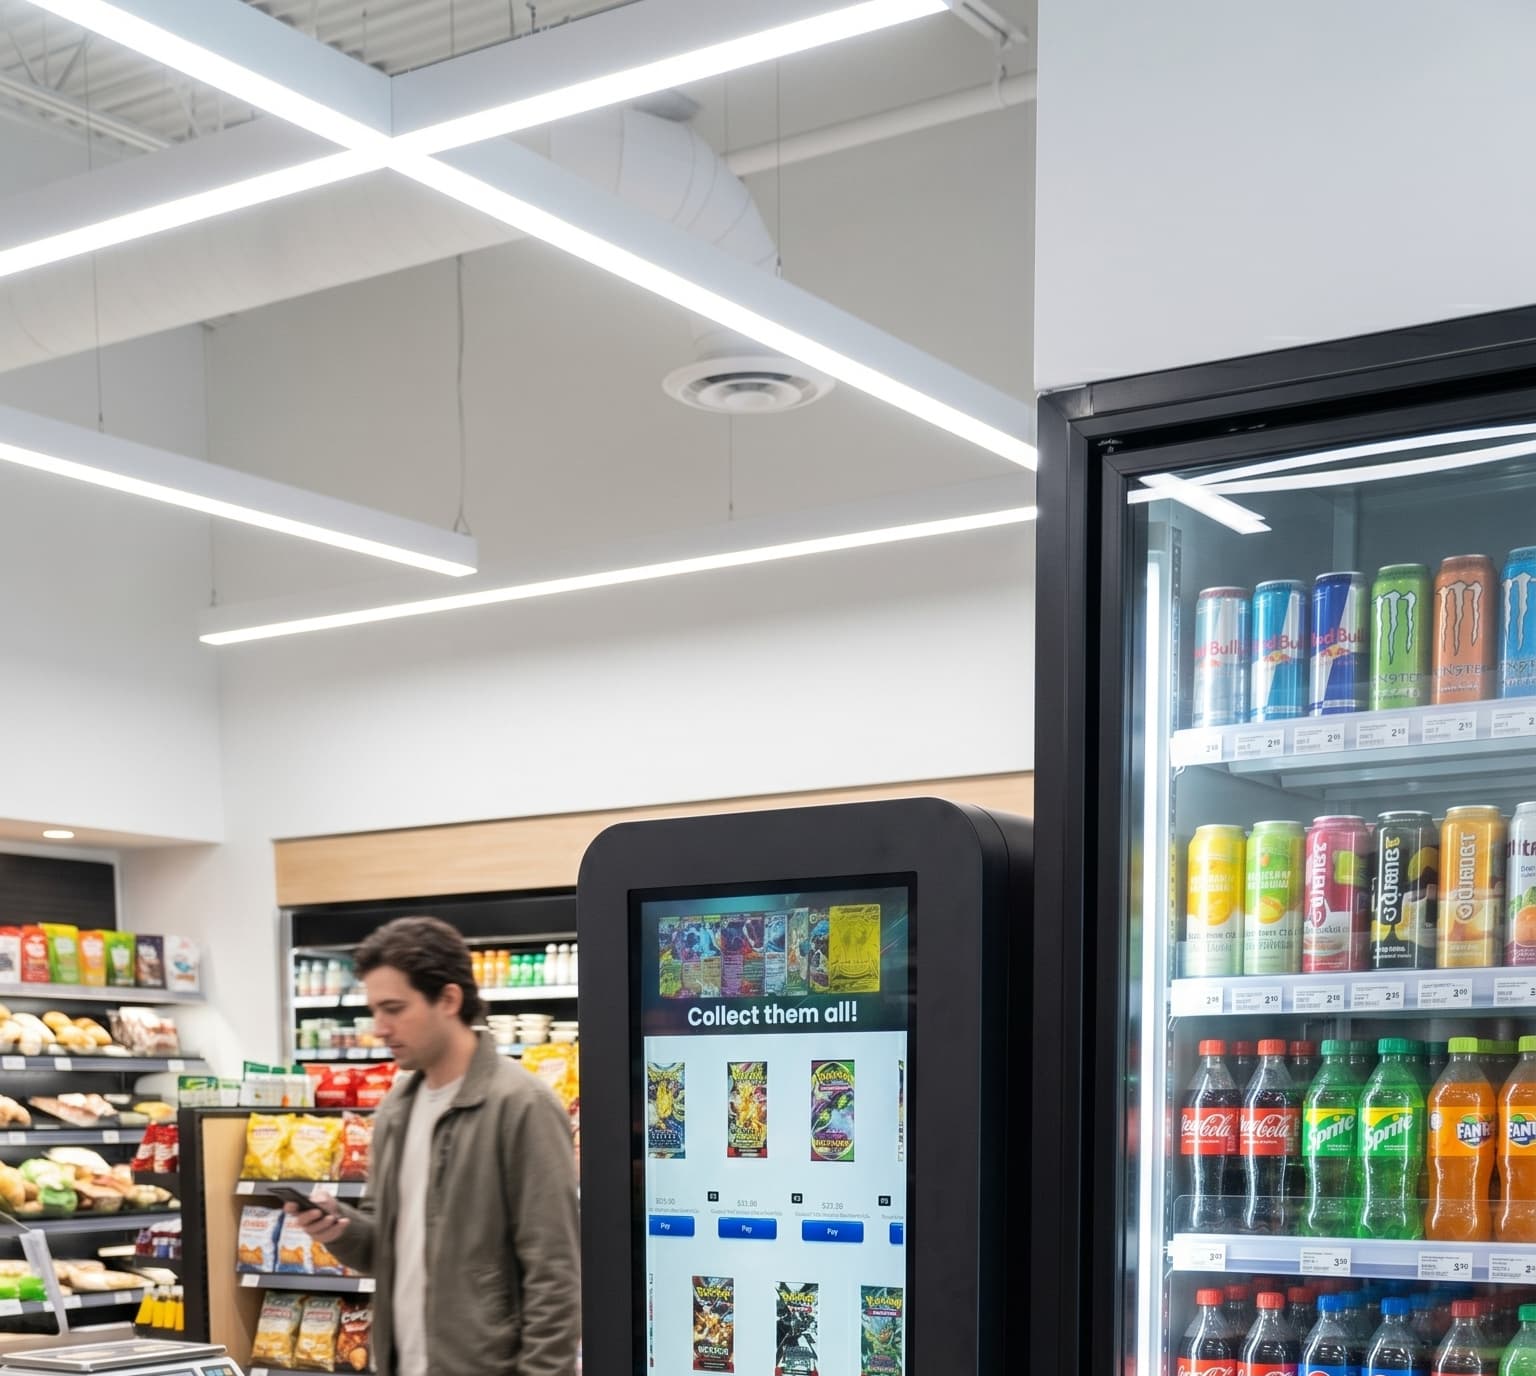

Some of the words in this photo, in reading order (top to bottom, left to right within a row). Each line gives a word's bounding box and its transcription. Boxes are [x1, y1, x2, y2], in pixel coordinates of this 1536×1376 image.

[687, 1005, 759, 1026] Collect
[764, 1003, 819, 1025] them
[824, 1000, 858, 1023] all!
[1308, 1115, 1355, 1151] Sprite
[1364, 1113, 1414, 1151] Sprite
